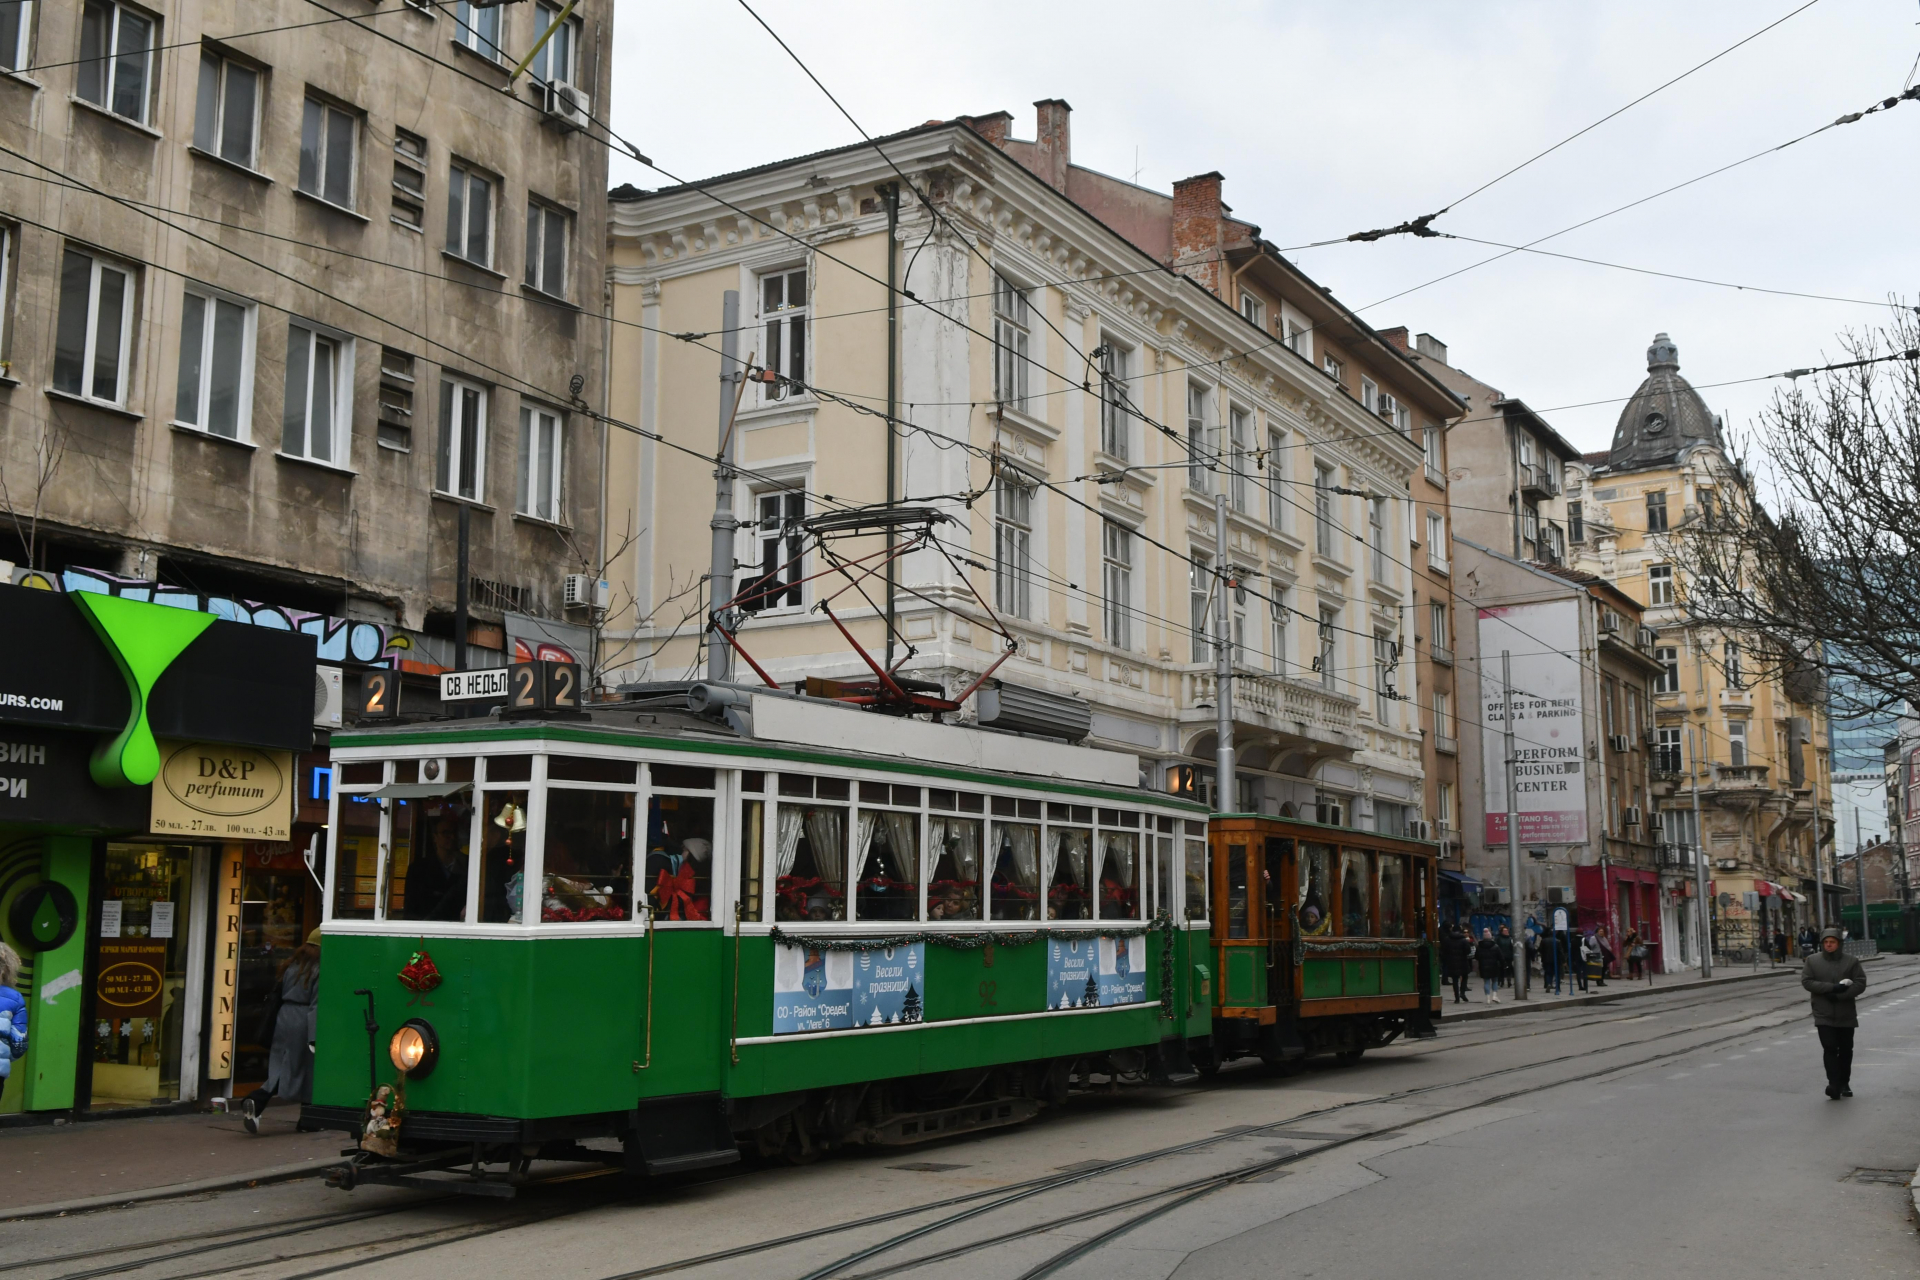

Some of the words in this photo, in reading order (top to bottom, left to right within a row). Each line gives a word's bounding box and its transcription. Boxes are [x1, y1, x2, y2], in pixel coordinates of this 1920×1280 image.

[366, 675, 385, 712] 2
[447, 677, 464, 696] СВ.
[515, 666, 534, 706] 2
[555, 666, 574, 706] 2
[1488, 702, 1524, 711] OFFES
[1529, 700, 1546, 708] FOR
[1552, 698, 1576, 707] RENT
[1488, 713, 1515, 721] CLAS
[1518, 712, 1524, 720] A
[1537, 709, 1576, 718] PARKING
[1515, 747, 1578, 760] PERFORM
[198, 757, 254, 780] D&P
[1516, 764, 1578, 776] BUSINE
[1186, 768, 1193, 791] 2
[1516, 781, 1567, 792] CENTER
[185, 781, 264, 799] perfumum
[155, 819, 165, 828] 50
[191, 820, 202, 830] 27
[227, 824, 240, 833] 100
[262, 826, 273, 836] 43
[1495, 816, 1501, 824] 2,
[1504, 815, 1540, 823] PITANO
[219, 861, 242, 1070] PERFUMES
[1064, 957, 1084, 968] Весели
[876, 965, 903, 979] Весели
[869, 976, 909, 998] празници!
[979, 980, 997, 1008] 92
[777, 1006, 788, 1018] СО
[794, 1004, 816, 1017] Район
[825, 1018, 830, 1028] 6
